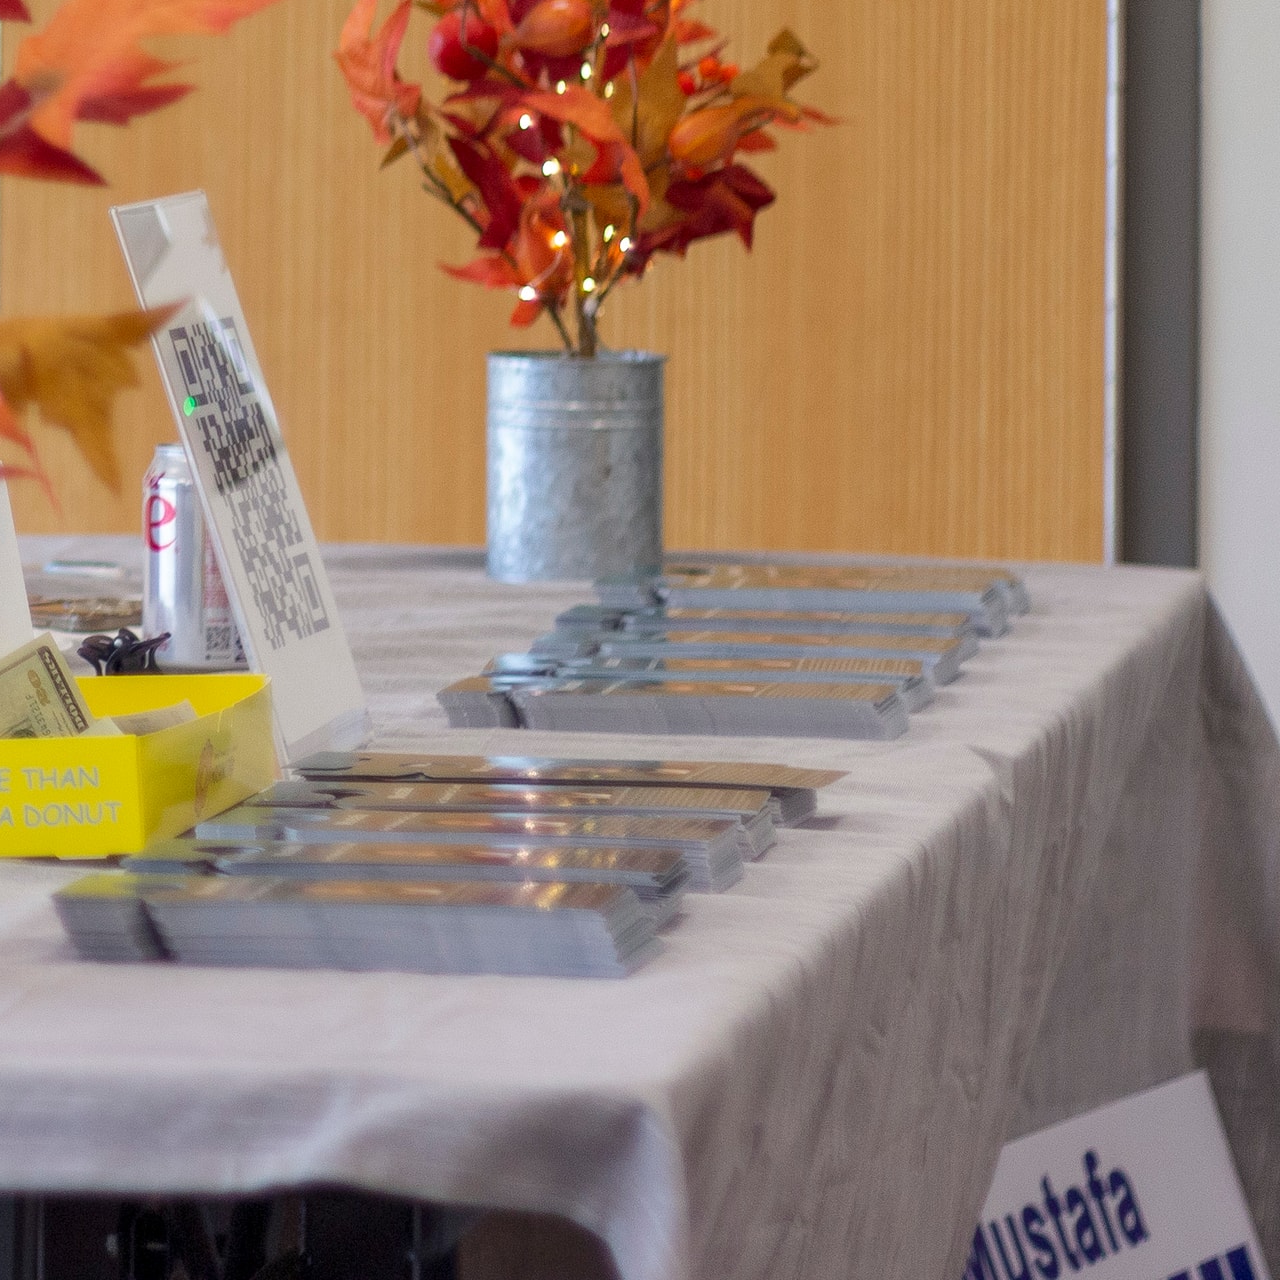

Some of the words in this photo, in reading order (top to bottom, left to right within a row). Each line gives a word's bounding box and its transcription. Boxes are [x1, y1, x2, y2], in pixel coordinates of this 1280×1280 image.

[41, 648, 87, 732] DOLLARS
[20, 765, 101, 790] THAN
[23, 800, 123, 828] DONUT
